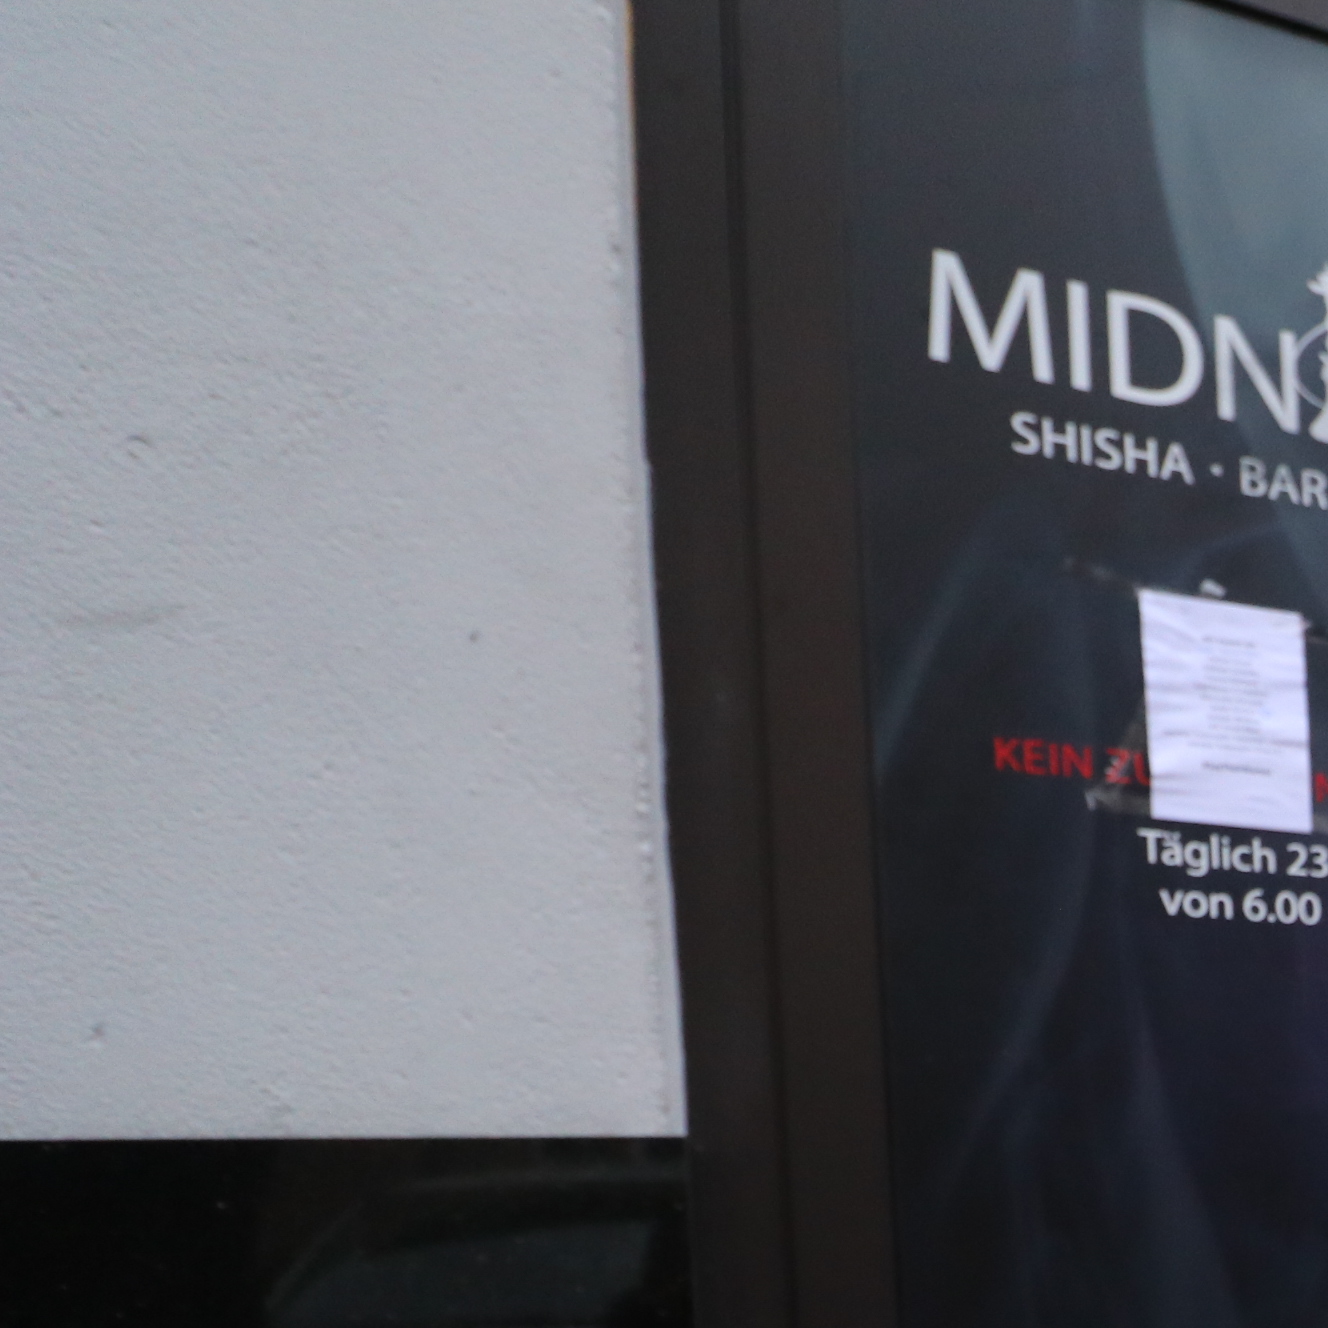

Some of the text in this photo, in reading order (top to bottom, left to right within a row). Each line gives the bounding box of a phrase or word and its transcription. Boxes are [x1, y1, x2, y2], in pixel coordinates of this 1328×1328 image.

[1010, 410, 1195, 484] SHISHA
[993, 737, 1093, 780] KEIN
[1136, 826, 1277, 877] Täglich
[1160, 888, 1234, 921] von
[1242, 888, 1322, 926] 6.00
